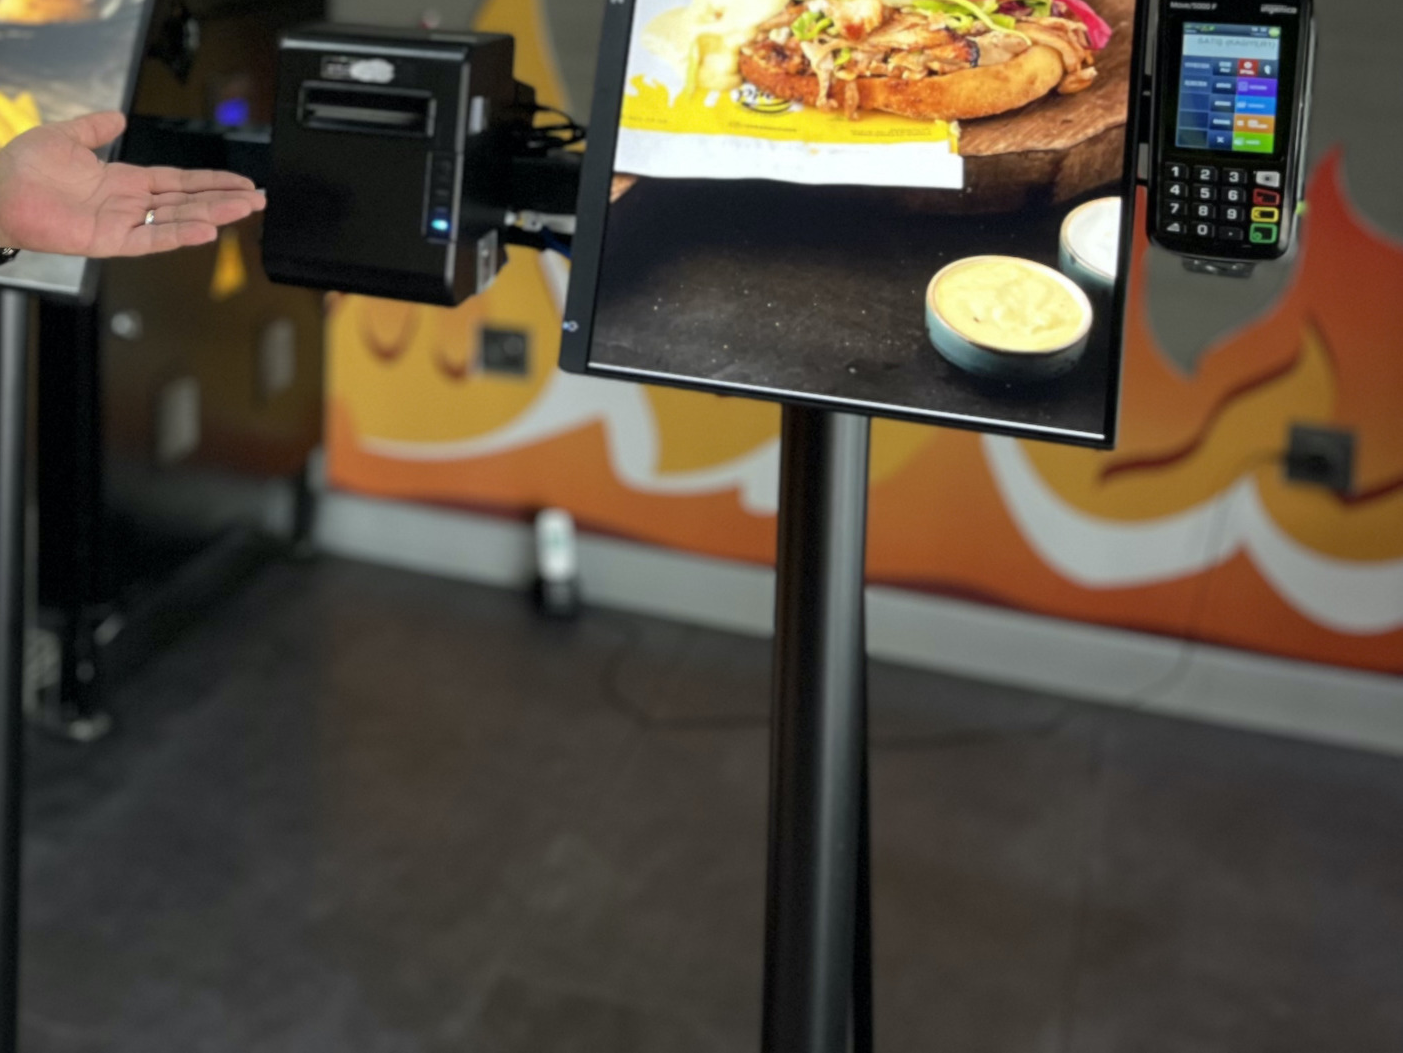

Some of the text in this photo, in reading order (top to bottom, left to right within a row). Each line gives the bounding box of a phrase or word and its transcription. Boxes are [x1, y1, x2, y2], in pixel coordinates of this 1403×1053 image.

[1171, 166, 1239, 182] 1 2 3
[1169, 184, 1238, 201] 4 5 6
[1170, 202, 1237, 220] 7 8 9
[1197, 224, 1208, 235] 0
